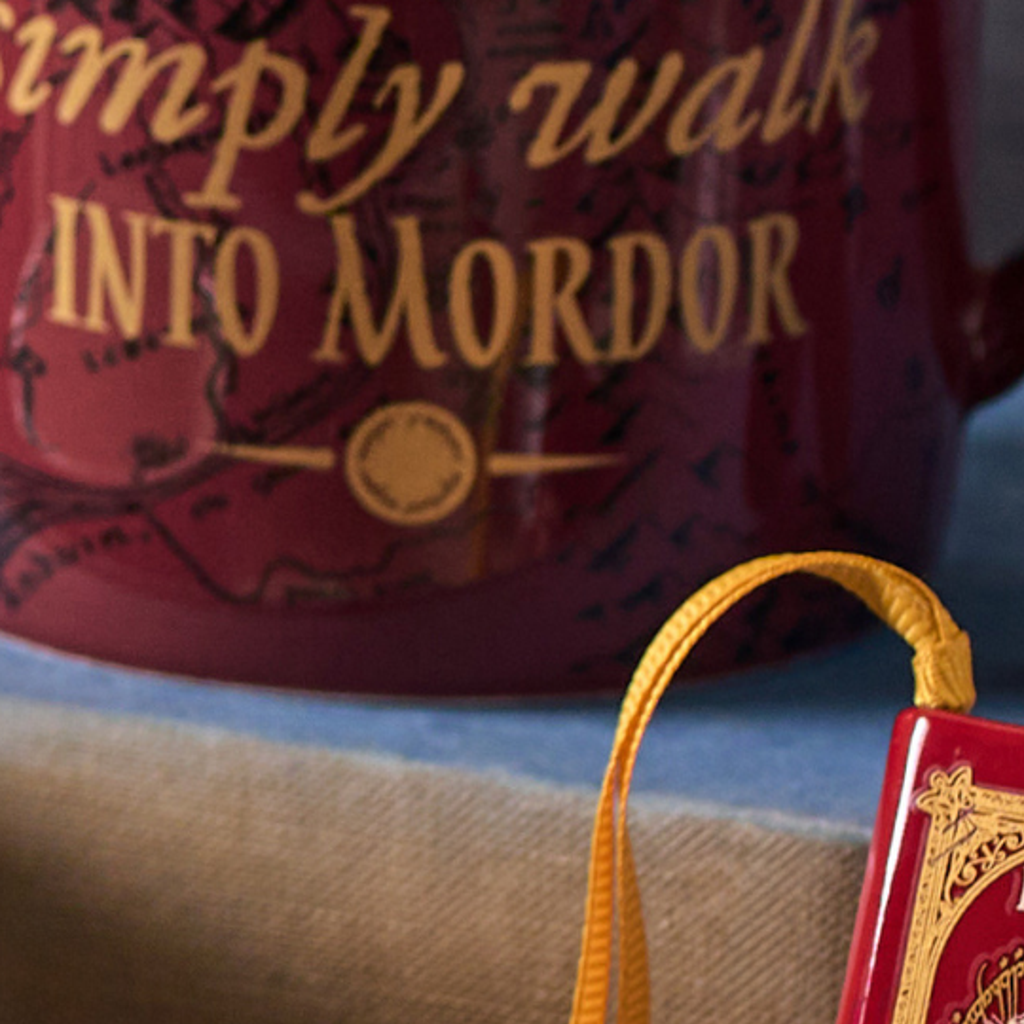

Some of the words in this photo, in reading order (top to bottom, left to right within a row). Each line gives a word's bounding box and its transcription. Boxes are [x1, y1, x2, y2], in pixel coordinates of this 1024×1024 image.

[0, 4, 466, 215] imply
[509, 0, 881, 169] walk
[49, 194, 280, 355] INTO
[311, 212, 808, 369] MORDOR
